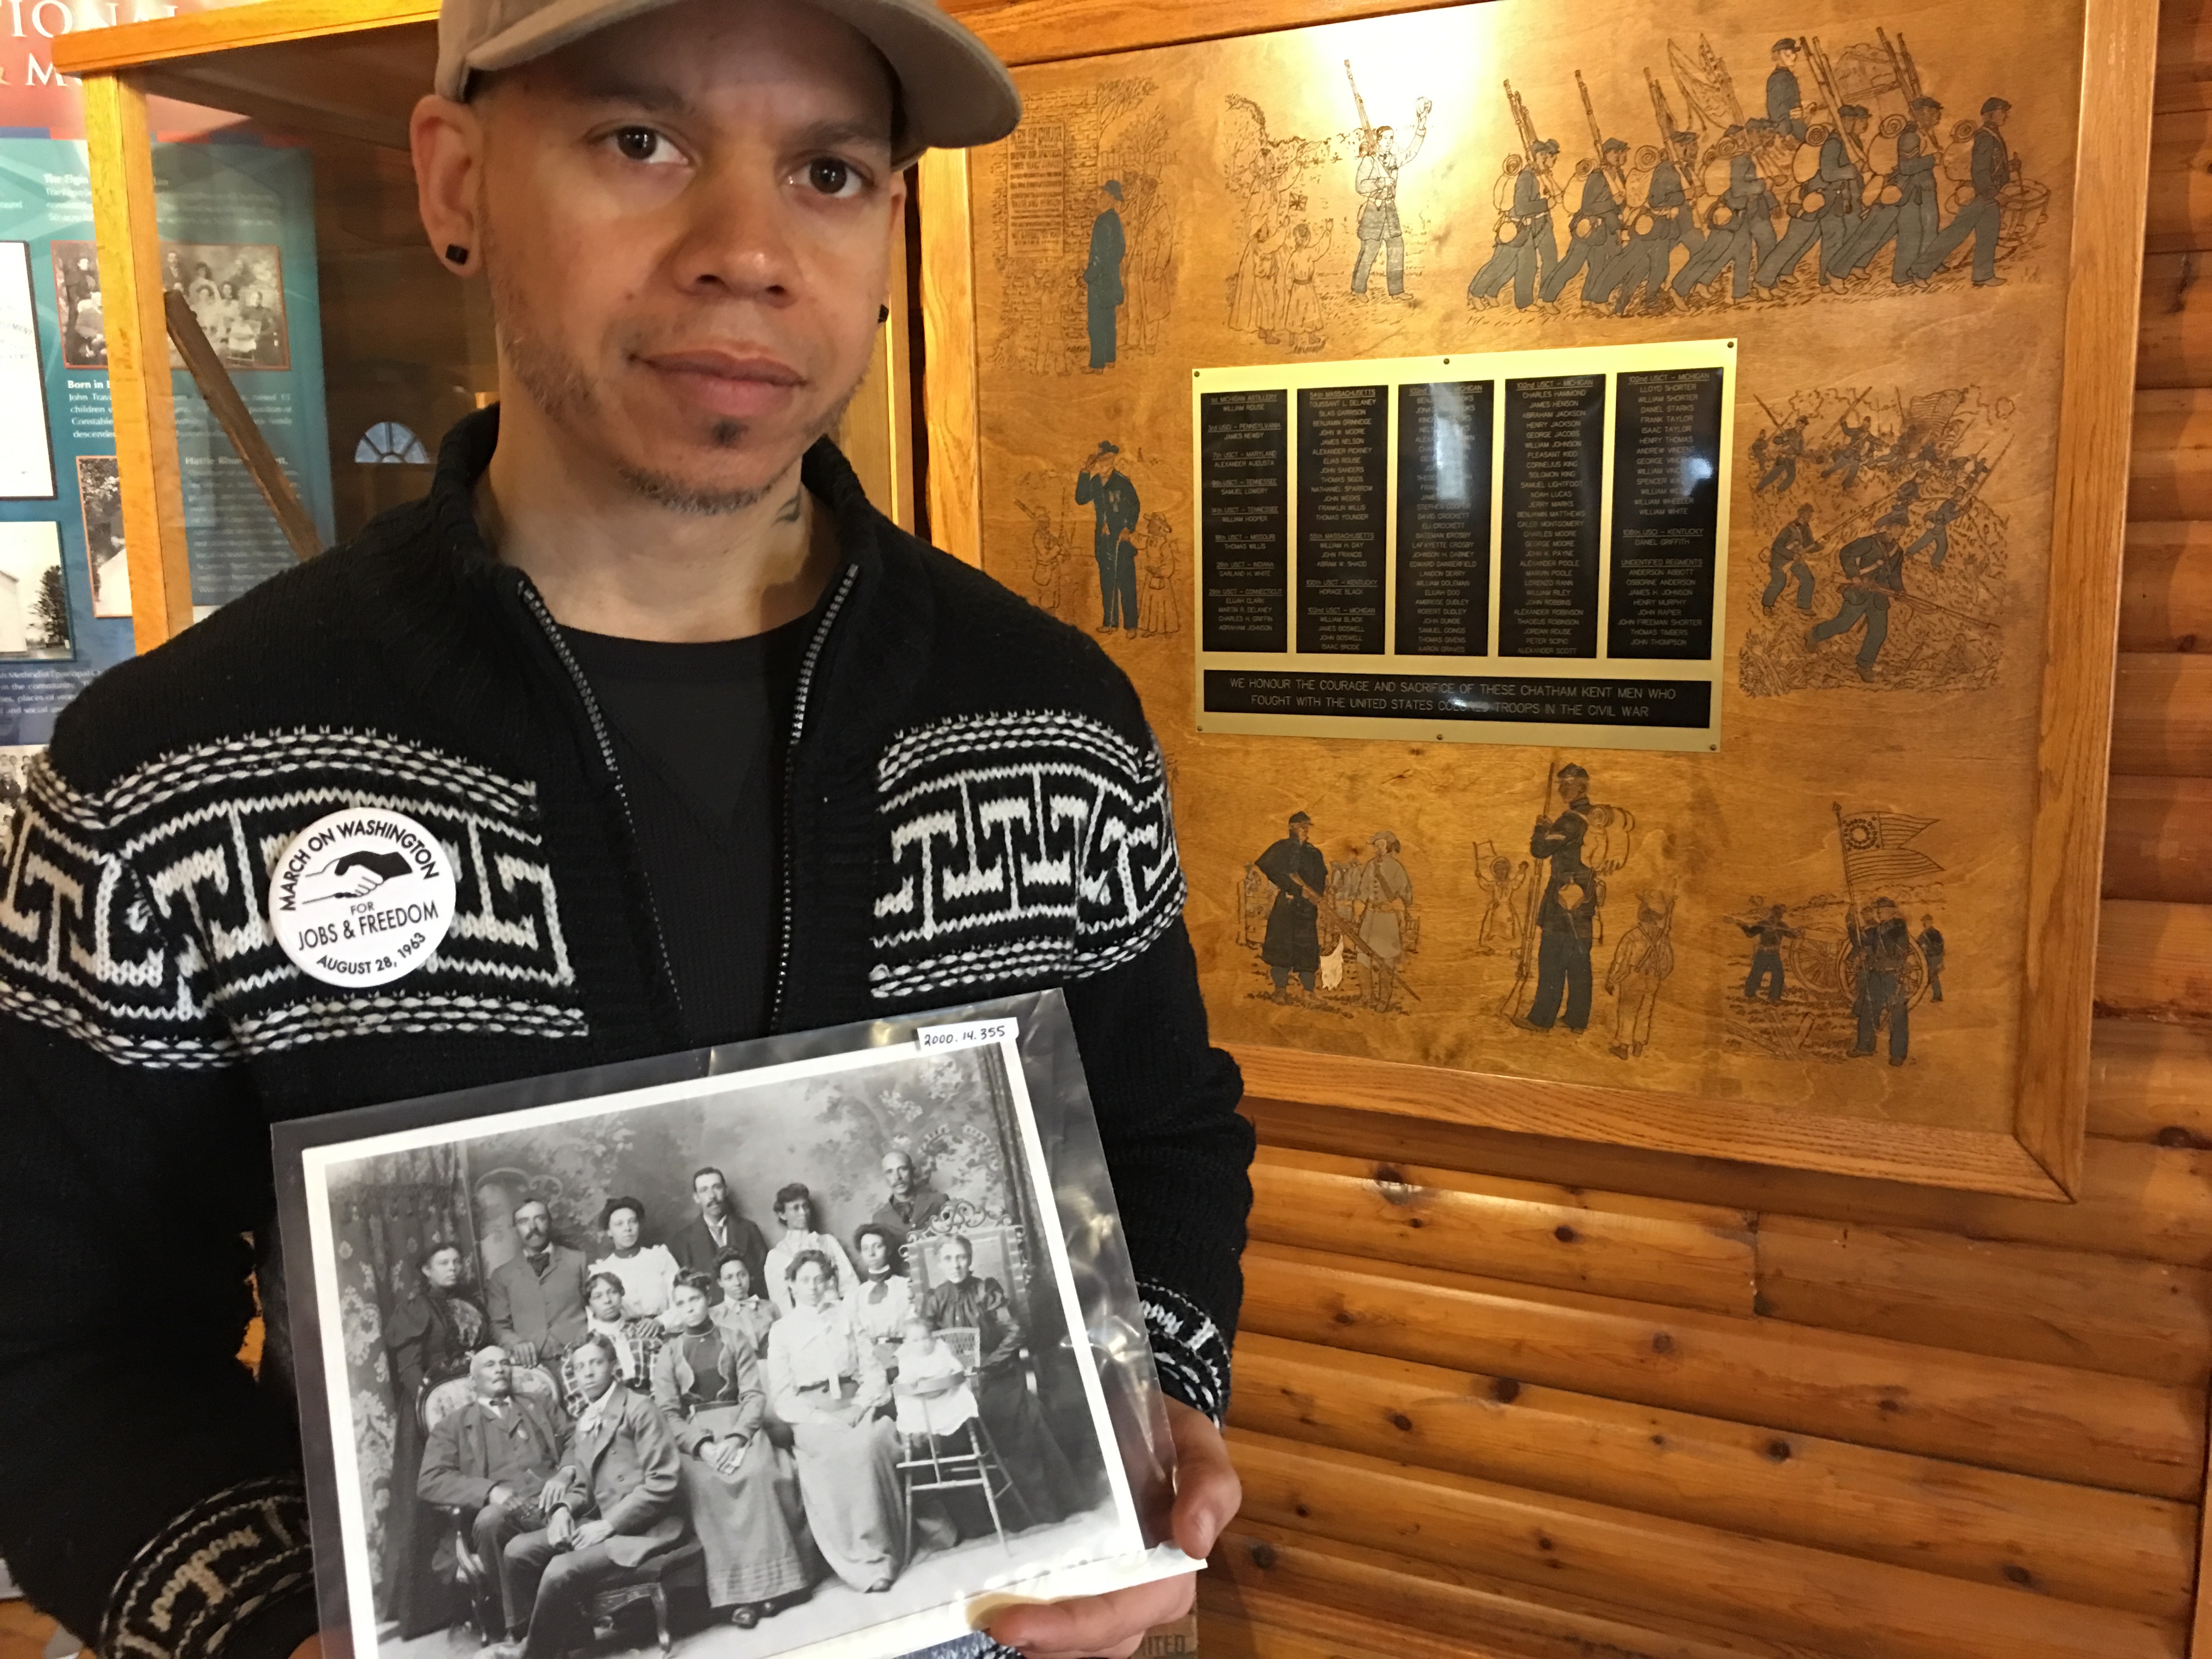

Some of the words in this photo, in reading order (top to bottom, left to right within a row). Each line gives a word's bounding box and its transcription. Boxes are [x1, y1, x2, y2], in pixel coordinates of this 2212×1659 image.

[67, 380, 91, 388] Born
[94, 380, 104, 388] in
[69, 393, 88, 402] John
[1229, 678, 1245, 688] WE
[1248, 678, 1291, 689] HONOUR
[1295, 679, 1316, 690] THE
[1318, 680, 1369, 691] COURAGE
[1373, 681, 1396, 692] AND
[1400, 682, 1455, 693] SACRIFICE
[1458, 683, 1474, 694] OF
[1479, 684, 1516, 695] THESE
[1519, 685, 1577, 697] CHATHAM
[1581, 686, 1612, 698] KENT
[1616, 687, 1643, 698] MEN
[1647, 687, 1677, 699] WHO
[1250, 695, 1290, 706] FOUGHT
[1295, 696, 1321, 707] WITH
[1325, 696, 1345, 707] THE
[1349, 697, 1387, 708] UNITED
[1390, 698, 1434, 710] STATES
[1494, 701, 1541, 713] TROOPS
[1544, 703, 1555, 714] IN
[1560, 703, 1583, 714] THE
[1587, 704, 1616, 715] CIVIL
[1620, 705, 1649, 716] WAR
[279, 848, 310, 911] MARCH
[308, 828, 334, 853] ON
[336, 820, 439, 879] WASHINGTON
[350, 902, 375, 916] FOR
[298, 923, 338, 951] JOBS
[343, 921, 356, 939] &
[359, 900, 439, 936] FREEDOM
[317, 955, 372, 975] AUGUST
[376, 956, 397, 970] 28,
[397, 933, 426, 958] 1963
